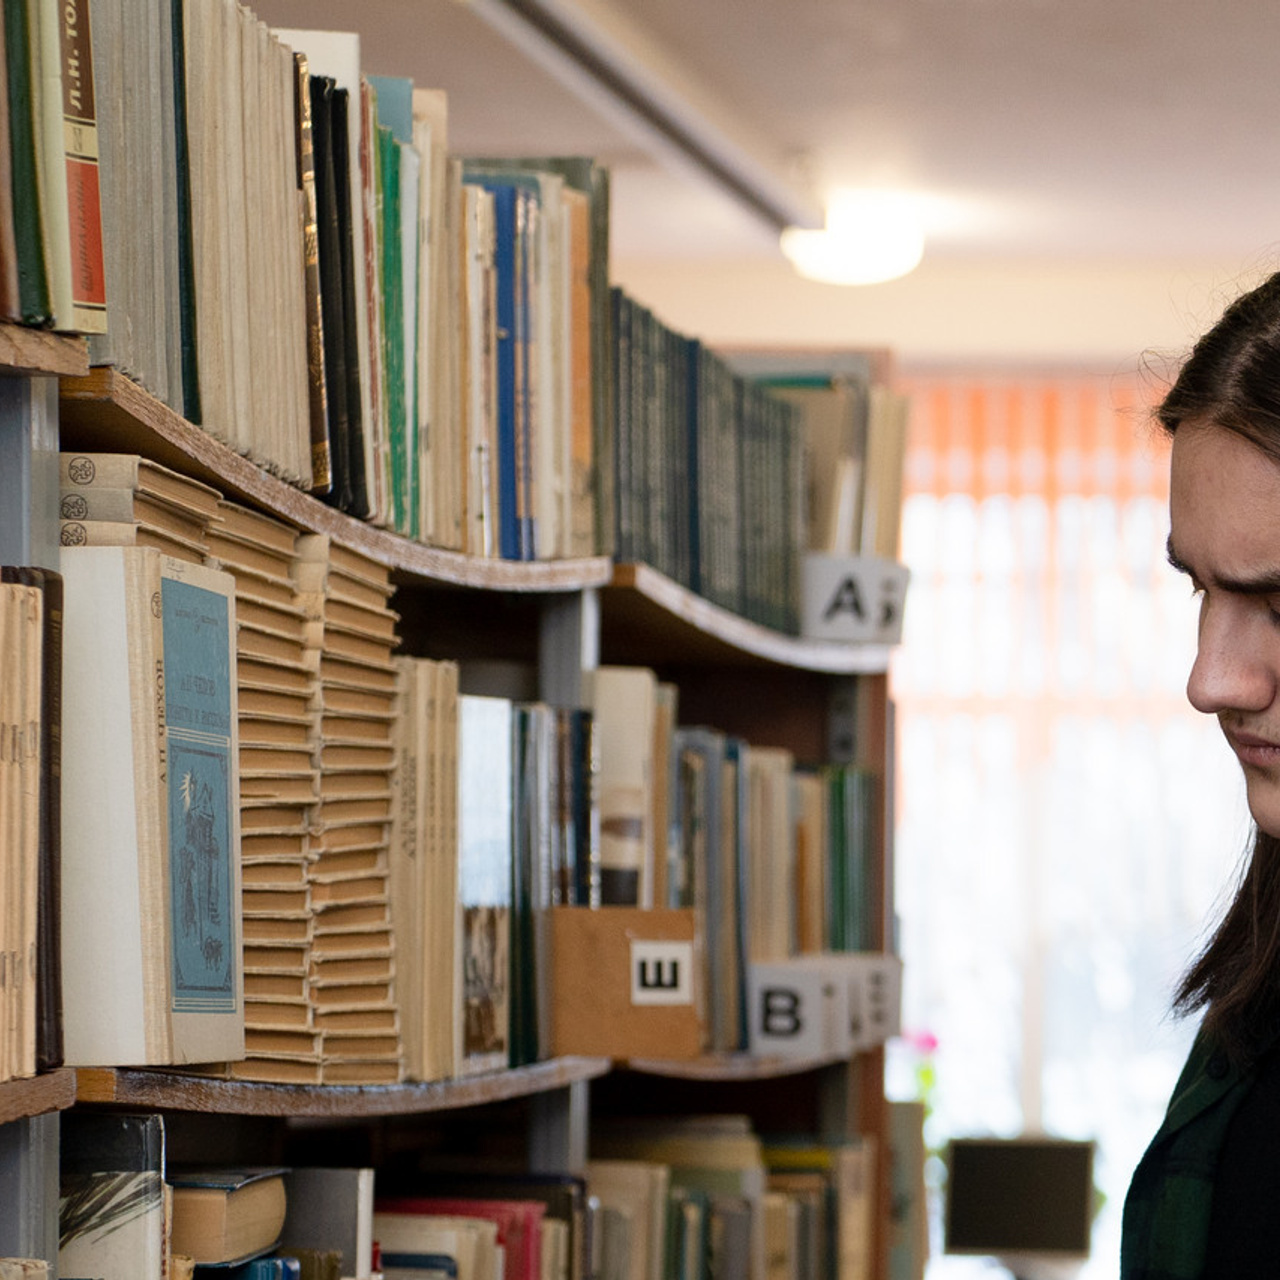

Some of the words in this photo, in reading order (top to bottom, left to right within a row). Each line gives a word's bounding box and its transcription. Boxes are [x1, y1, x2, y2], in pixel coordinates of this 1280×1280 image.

[68, 49, 82, 110] Л.Н.
[823, 573, 868, 623] А
[639, 959, 680, 990] Ш
[761, 986, 803, 1038] В
